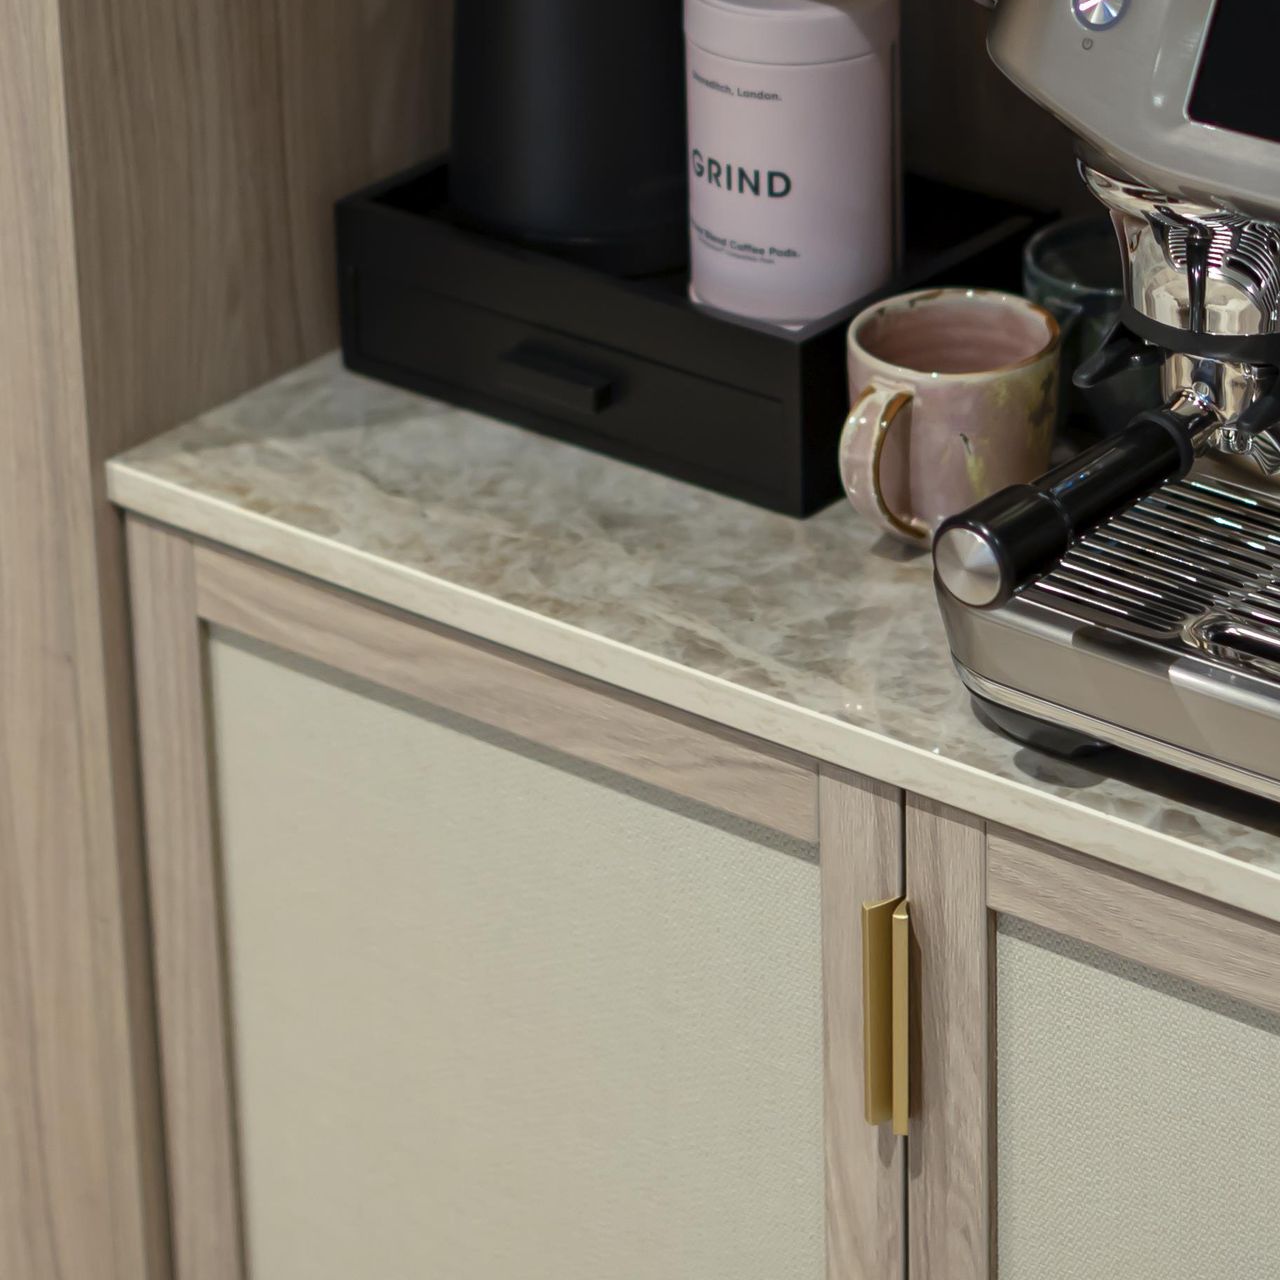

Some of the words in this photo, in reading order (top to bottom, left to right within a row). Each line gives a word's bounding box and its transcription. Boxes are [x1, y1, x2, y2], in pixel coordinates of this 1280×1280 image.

[736, 87, 783, 101] London.
[692, 148, 793, 198] GRIND
[729, 239, 766, 255] Coffee
